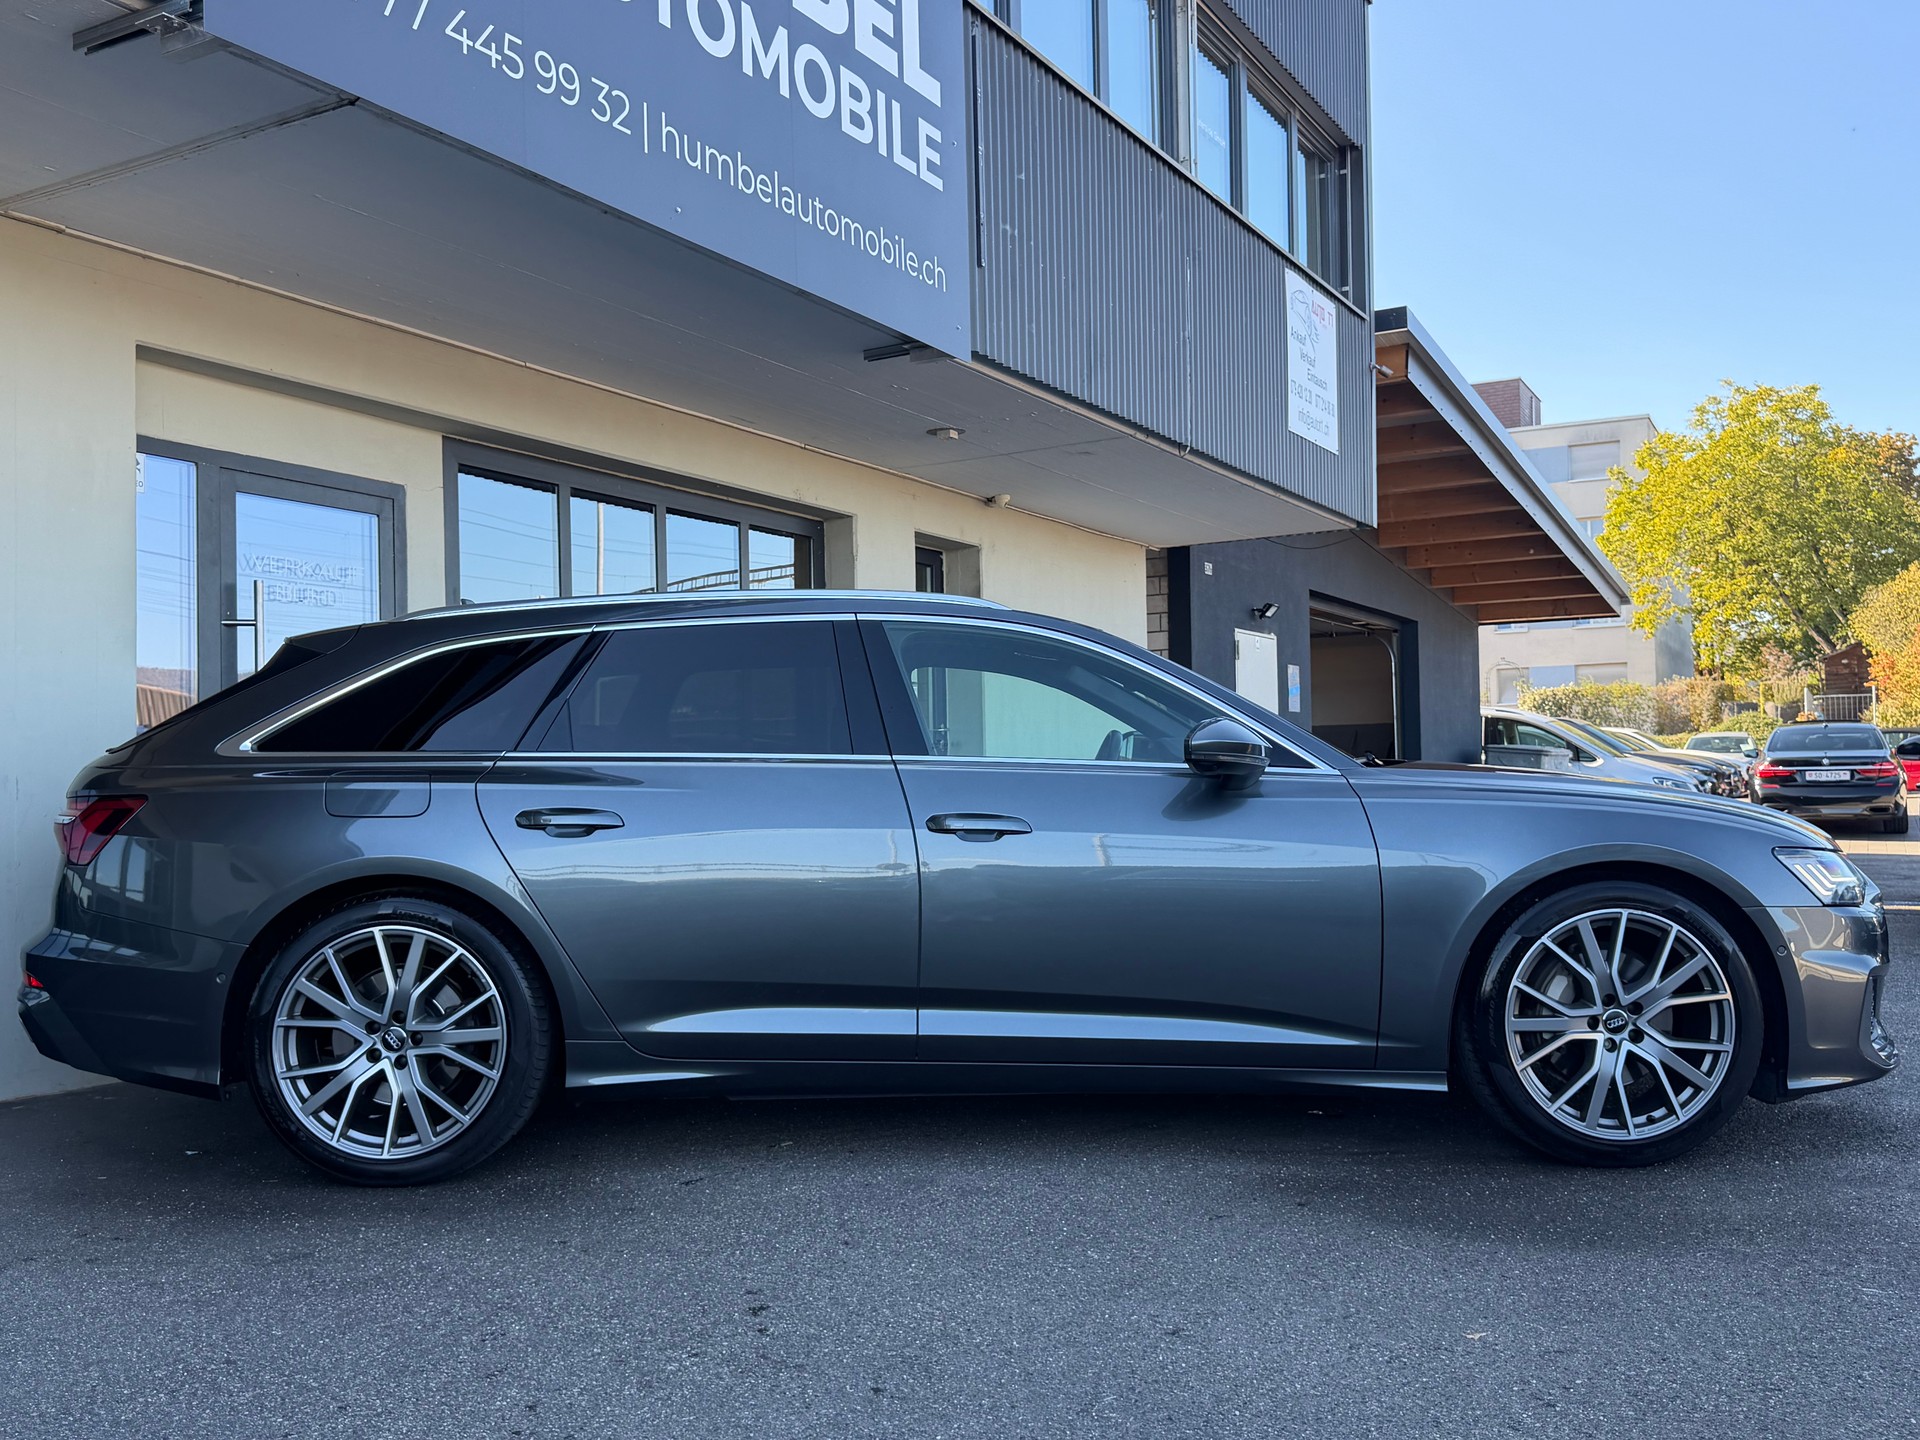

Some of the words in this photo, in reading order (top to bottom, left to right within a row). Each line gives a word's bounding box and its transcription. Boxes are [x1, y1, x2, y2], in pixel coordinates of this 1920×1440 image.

[445, 9, 525, 80] 445
[534, 50, 581, 106] 99
[591, 76, 632, 135] 32
[661, 111, 947, 292] humbelautomobile.ch
[792, 0, 941, 107] EL
